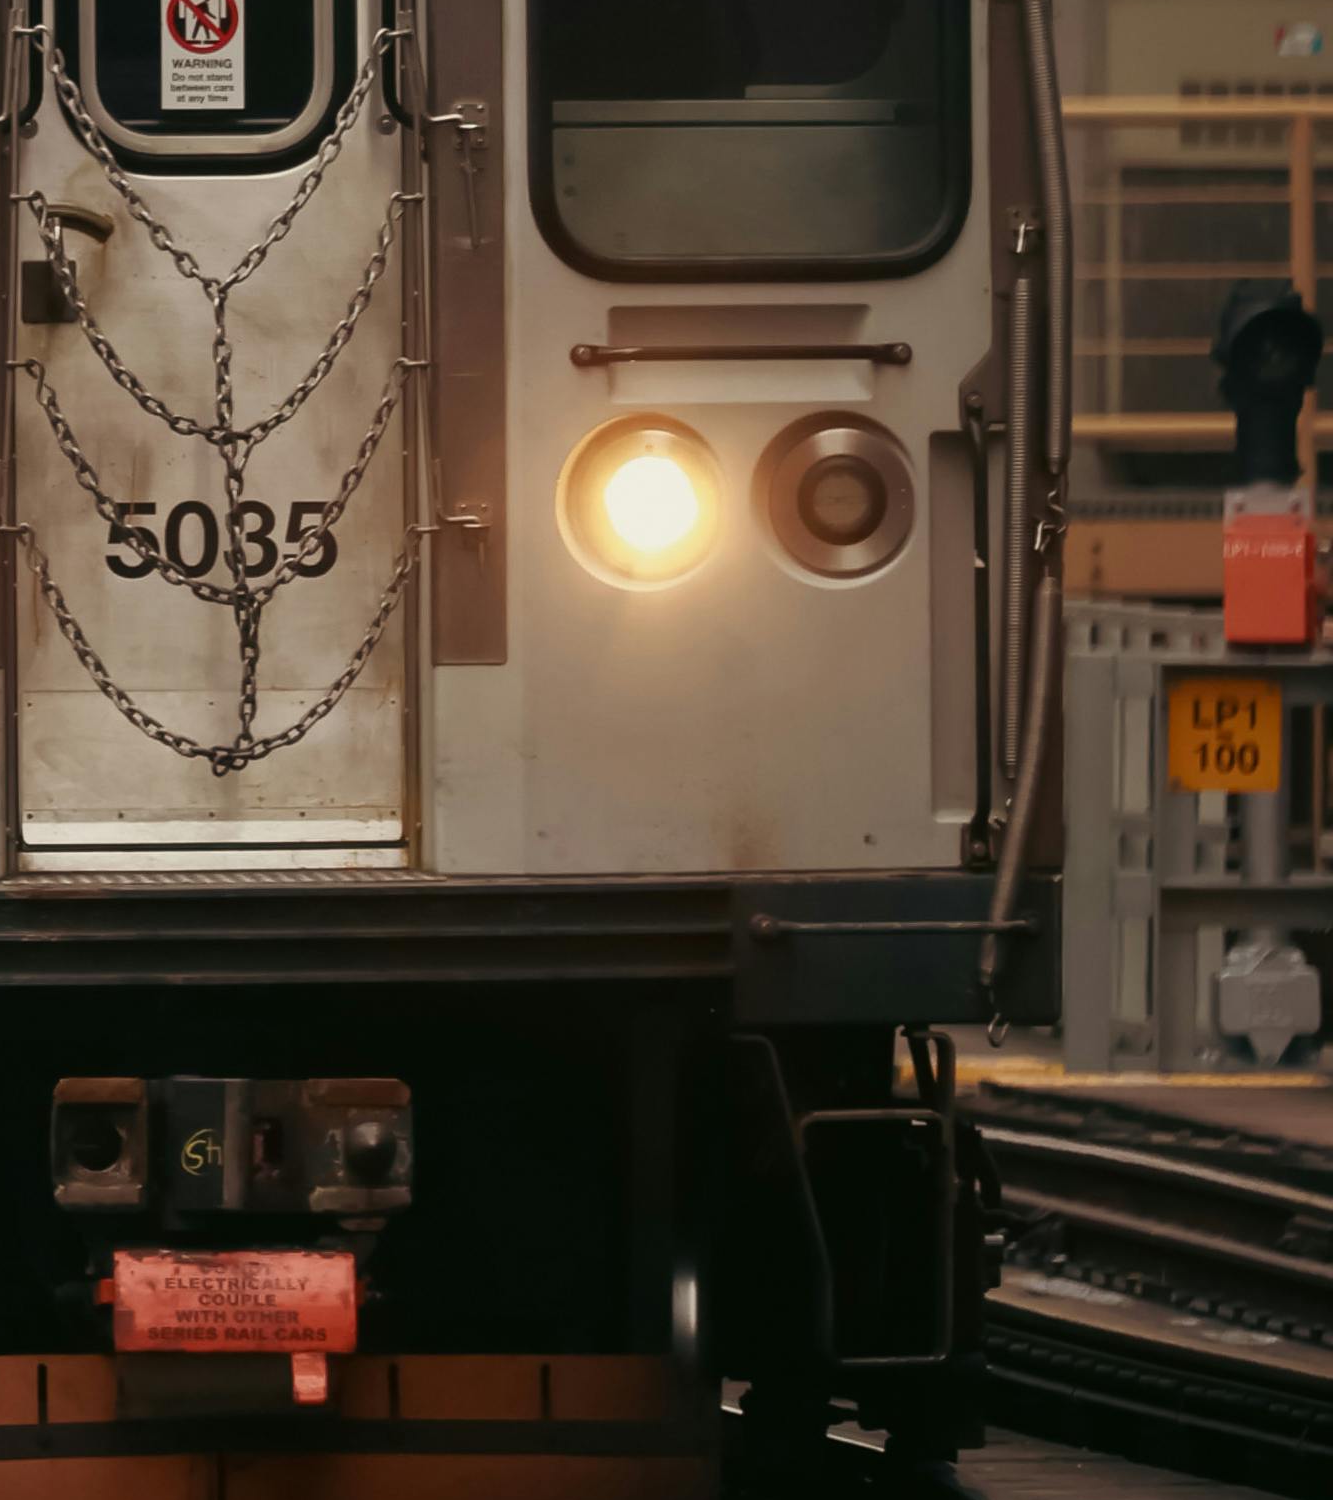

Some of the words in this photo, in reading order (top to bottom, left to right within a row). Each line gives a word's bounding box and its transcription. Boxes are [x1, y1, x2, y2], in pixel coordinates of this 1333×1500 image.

[171, 58, 233, 69] WARNING
[171, 73, 185, 82] Do
[187, 73, 203, 82] not
[206, 72, 233, 82] stand
[170, 84, 211, 93] between
[213, 84, 235, 93] cars
[176, 95, 185, 103] at
[188, 96, 206, 105] any
[207, 94, 229, 102] time
[105, 500, 338, 579] 5035
[1192, 696, 1257, 729] LP1
[1192, 741, 1260, 776] 100
[164, 1277, 310, 1291] ELECTRICALLY
[197, 1294, 277, 1306] COUPLE
[175, 1309, 227, 1324] WITH
[232, 1309, 299, 1324] OTHER
[147, 1327, 218, 1342] SERIES
[224, 1327, 267, 1342] RAIL
[274, 1326, 327, 1342] CARS
